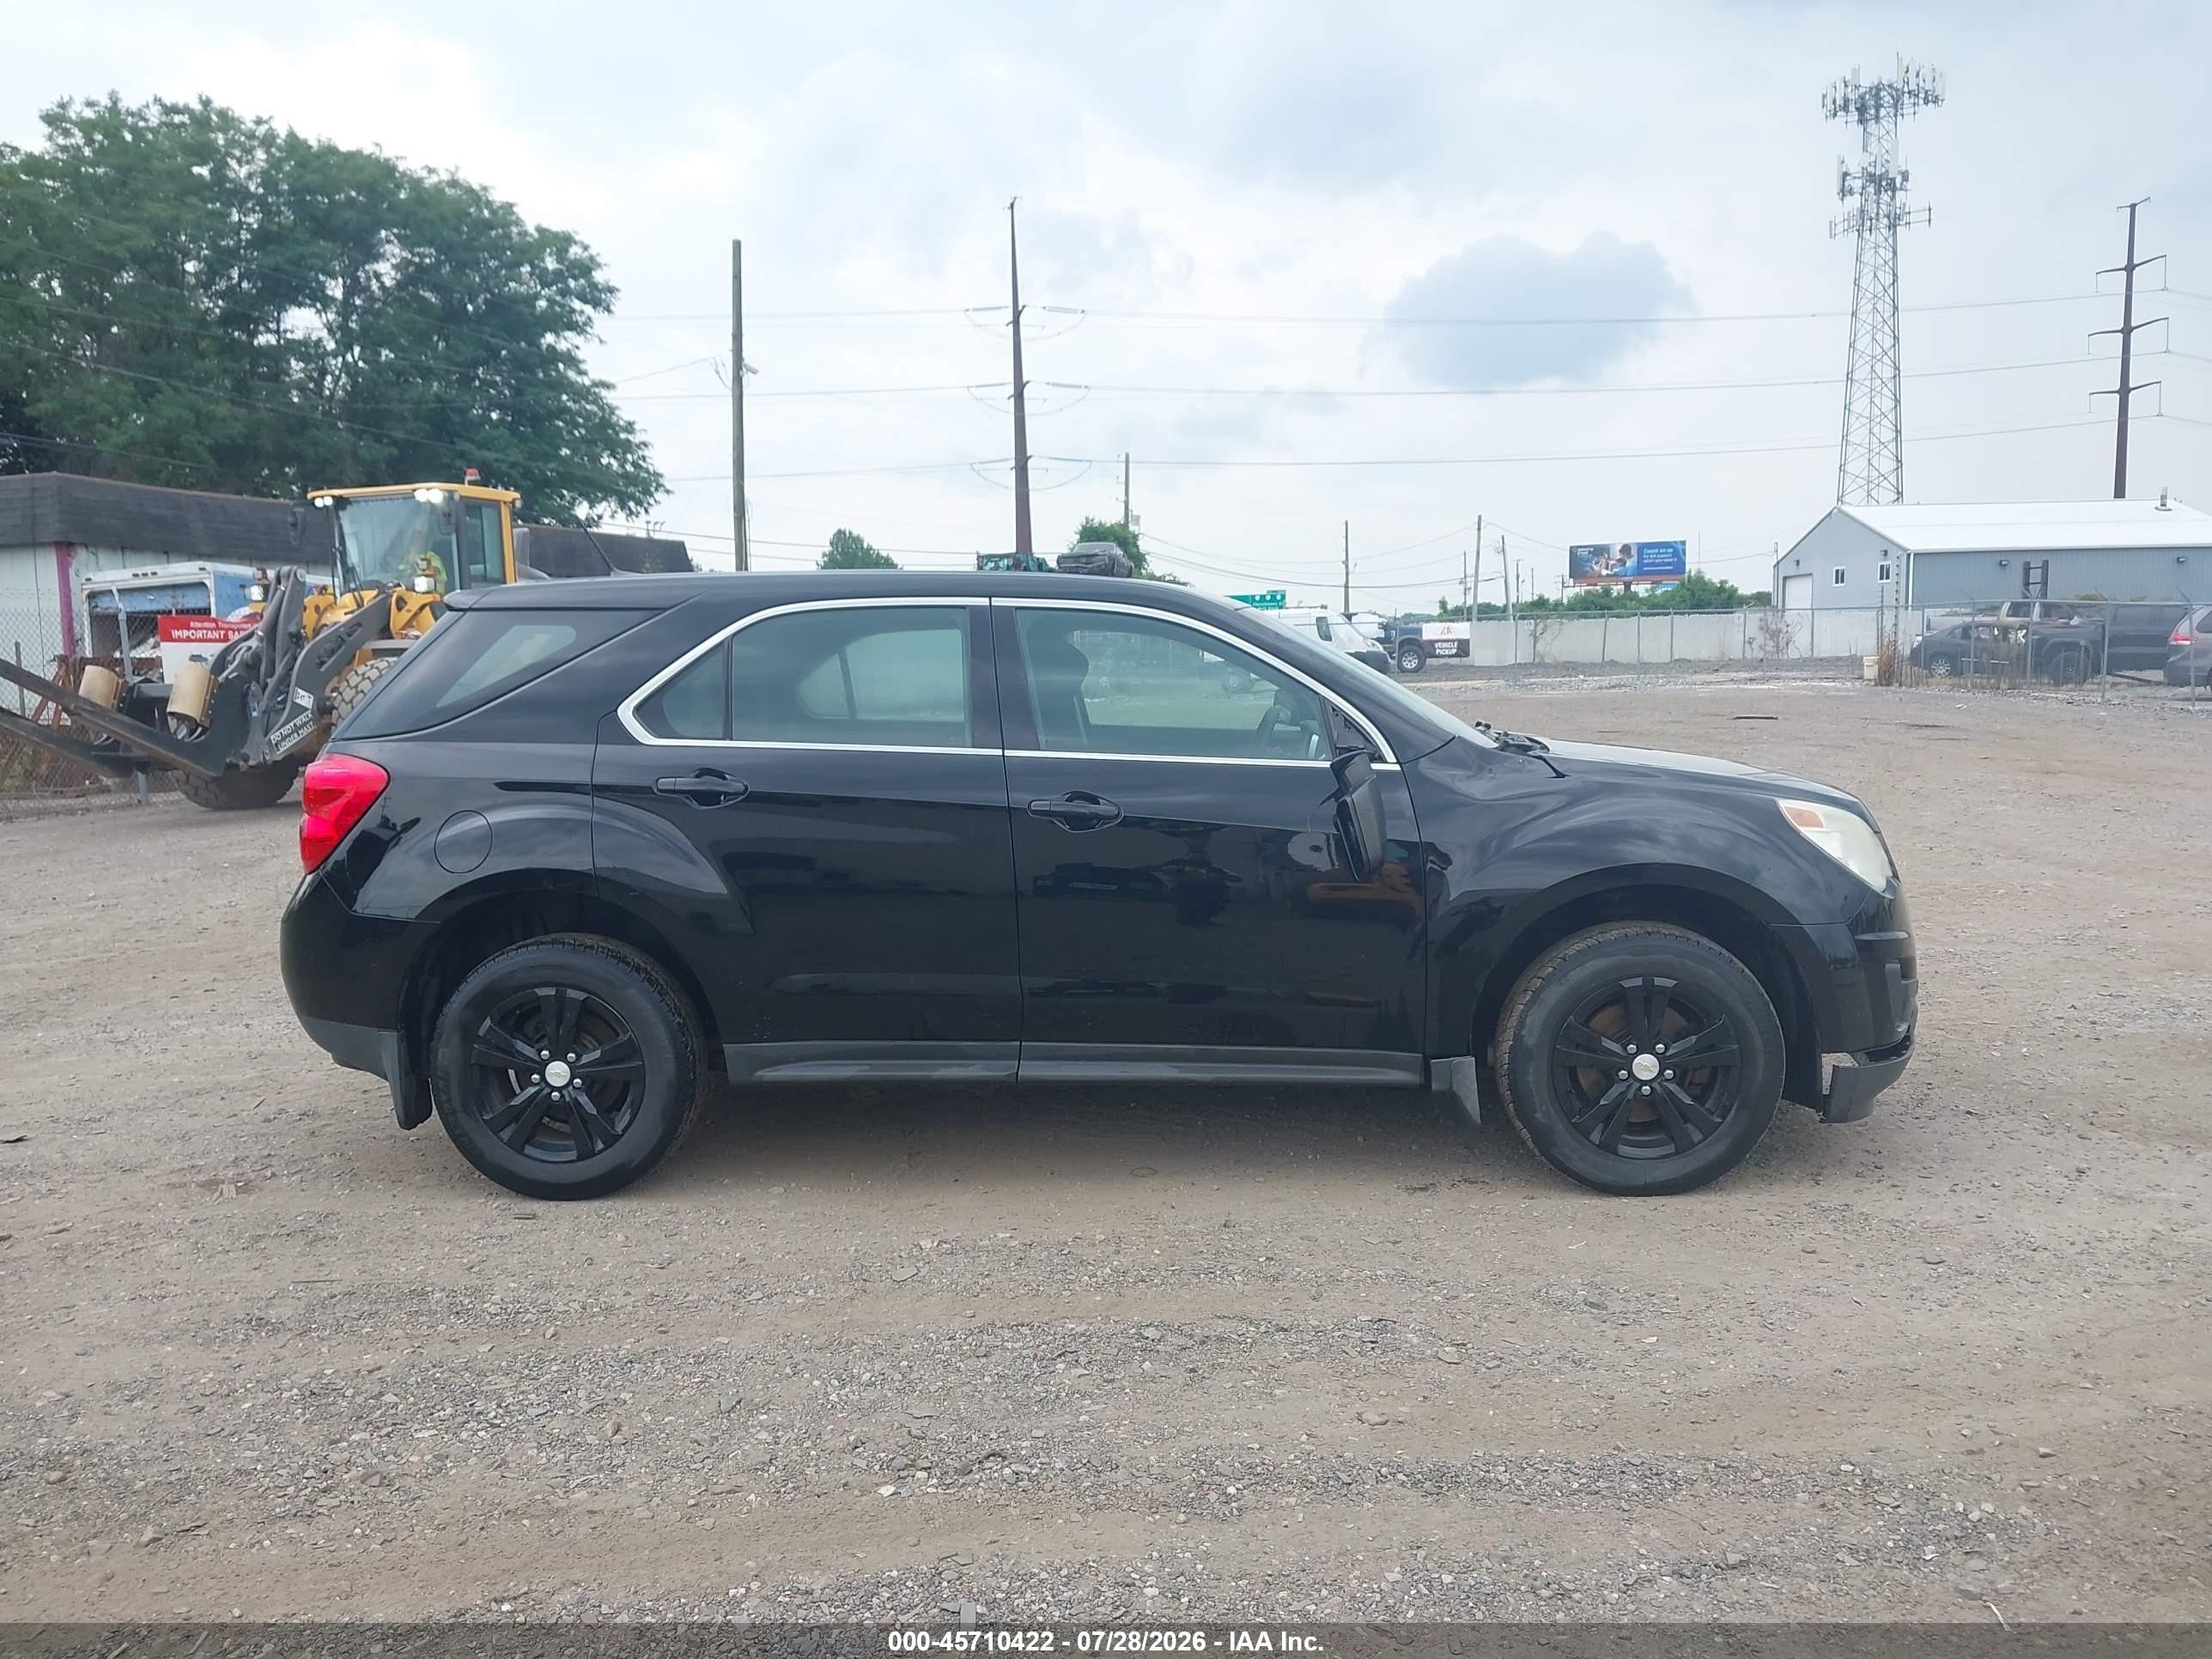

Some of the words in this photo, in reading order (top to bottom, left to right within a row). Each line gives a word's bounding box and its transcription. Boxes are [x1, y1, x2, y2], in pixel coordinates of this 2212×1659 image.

[171, 629, 226, 640] IMPORTANT
[270, 733, 282, 744] DO
[281, 722, 295, 737] NOT
[294, 713, 313, 727] WALK
[277, 732, 300, 750] UNDER
[298, 720, 317, 738] MAST
